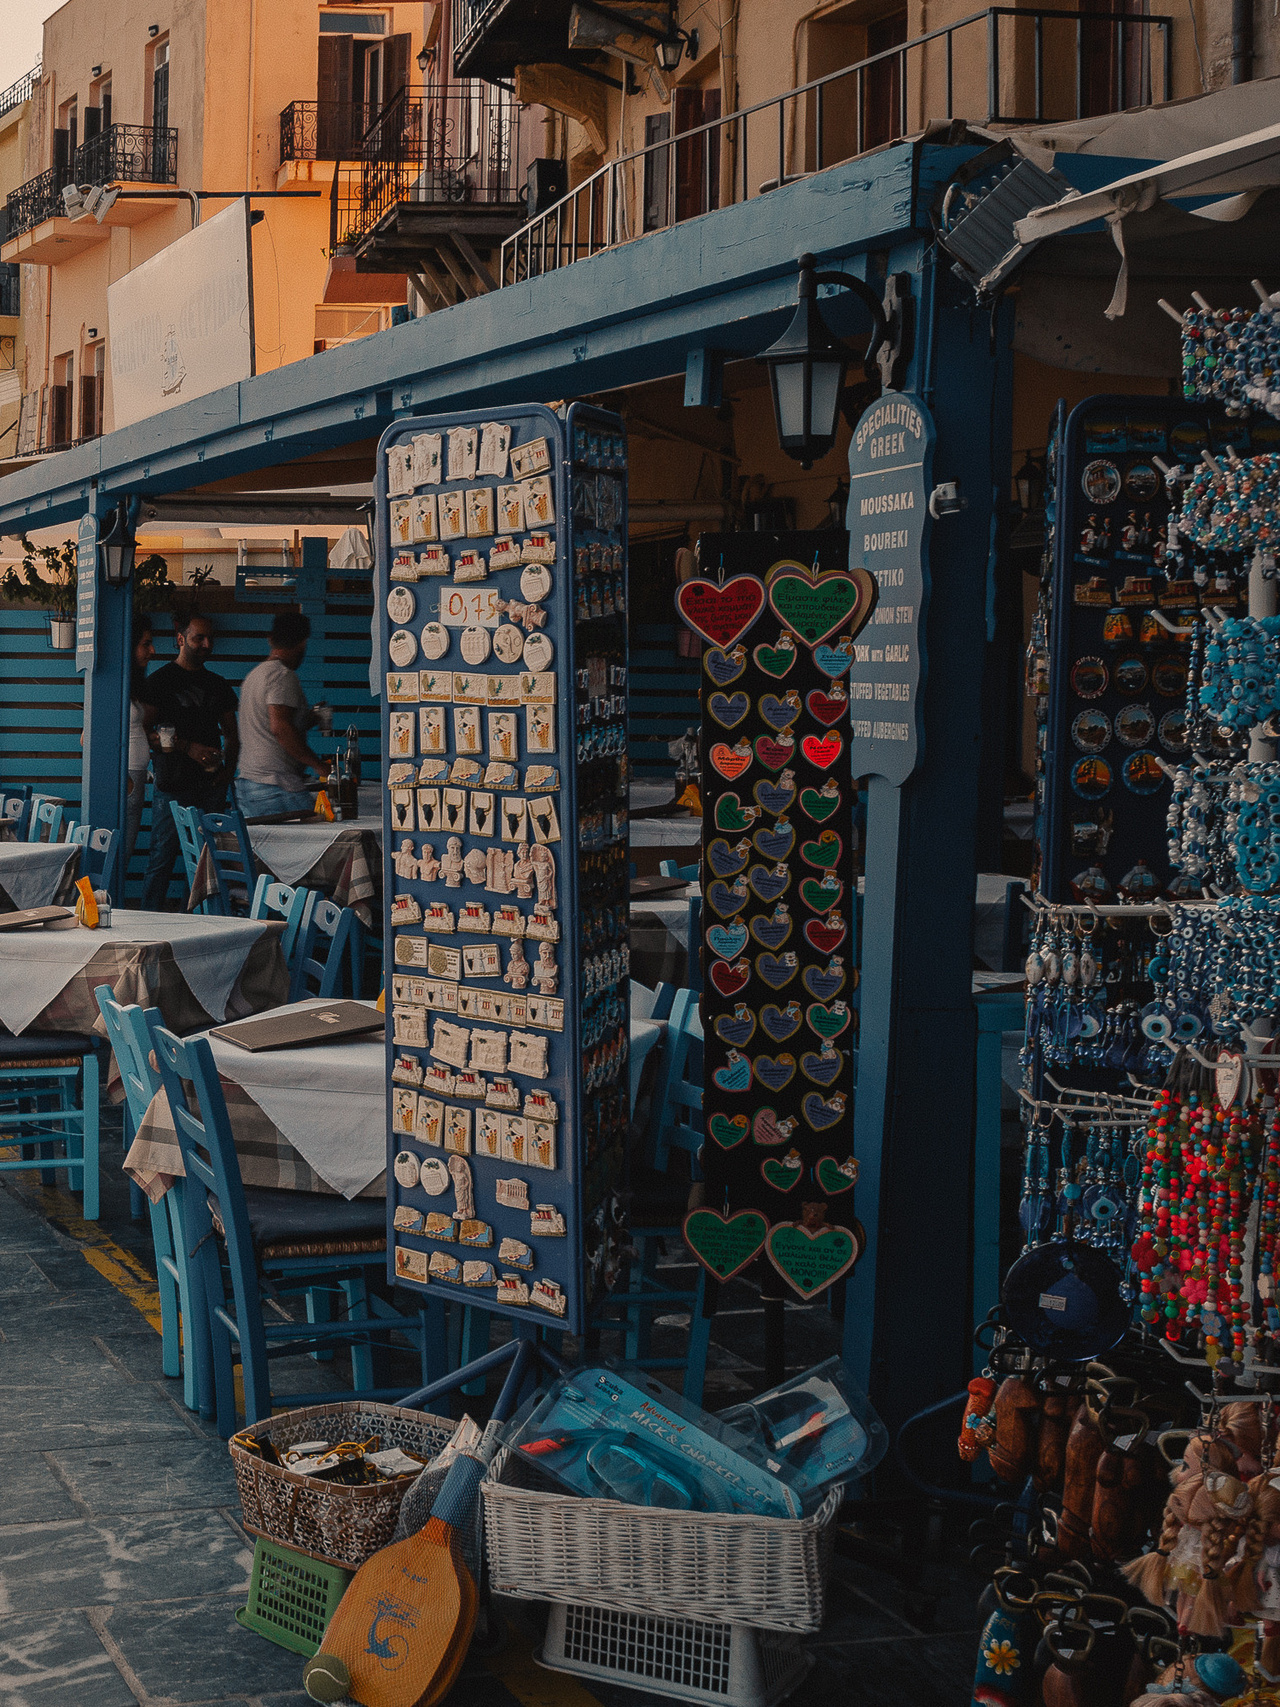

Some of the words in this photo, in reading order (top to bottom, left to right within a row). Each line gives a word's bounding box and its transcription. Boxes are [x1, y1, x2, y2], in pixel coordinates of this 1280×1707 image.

[856, 403, 923, 452] SPECIALITIES
[870, 431, 906, 459] GREEK
[860, 491, 914, 516] MOUSSAKA
[864, 530, 908, 551] BOUREKI
[874, 568, 904, 587] FTIKO
[449, 592, 497, 623] 0,75
[896, 606, 914, 624] STEW
[885, 644, 910, 663] GARLIC
[874, 683, 910, 701] VEGETABLES
[851, 720, 871, 738] TUFFED
[598, 1375, 624, 1396] Scuba
[640, 1401, 687, 1433] Advanced
[665, 1434, 678, 1446] &
